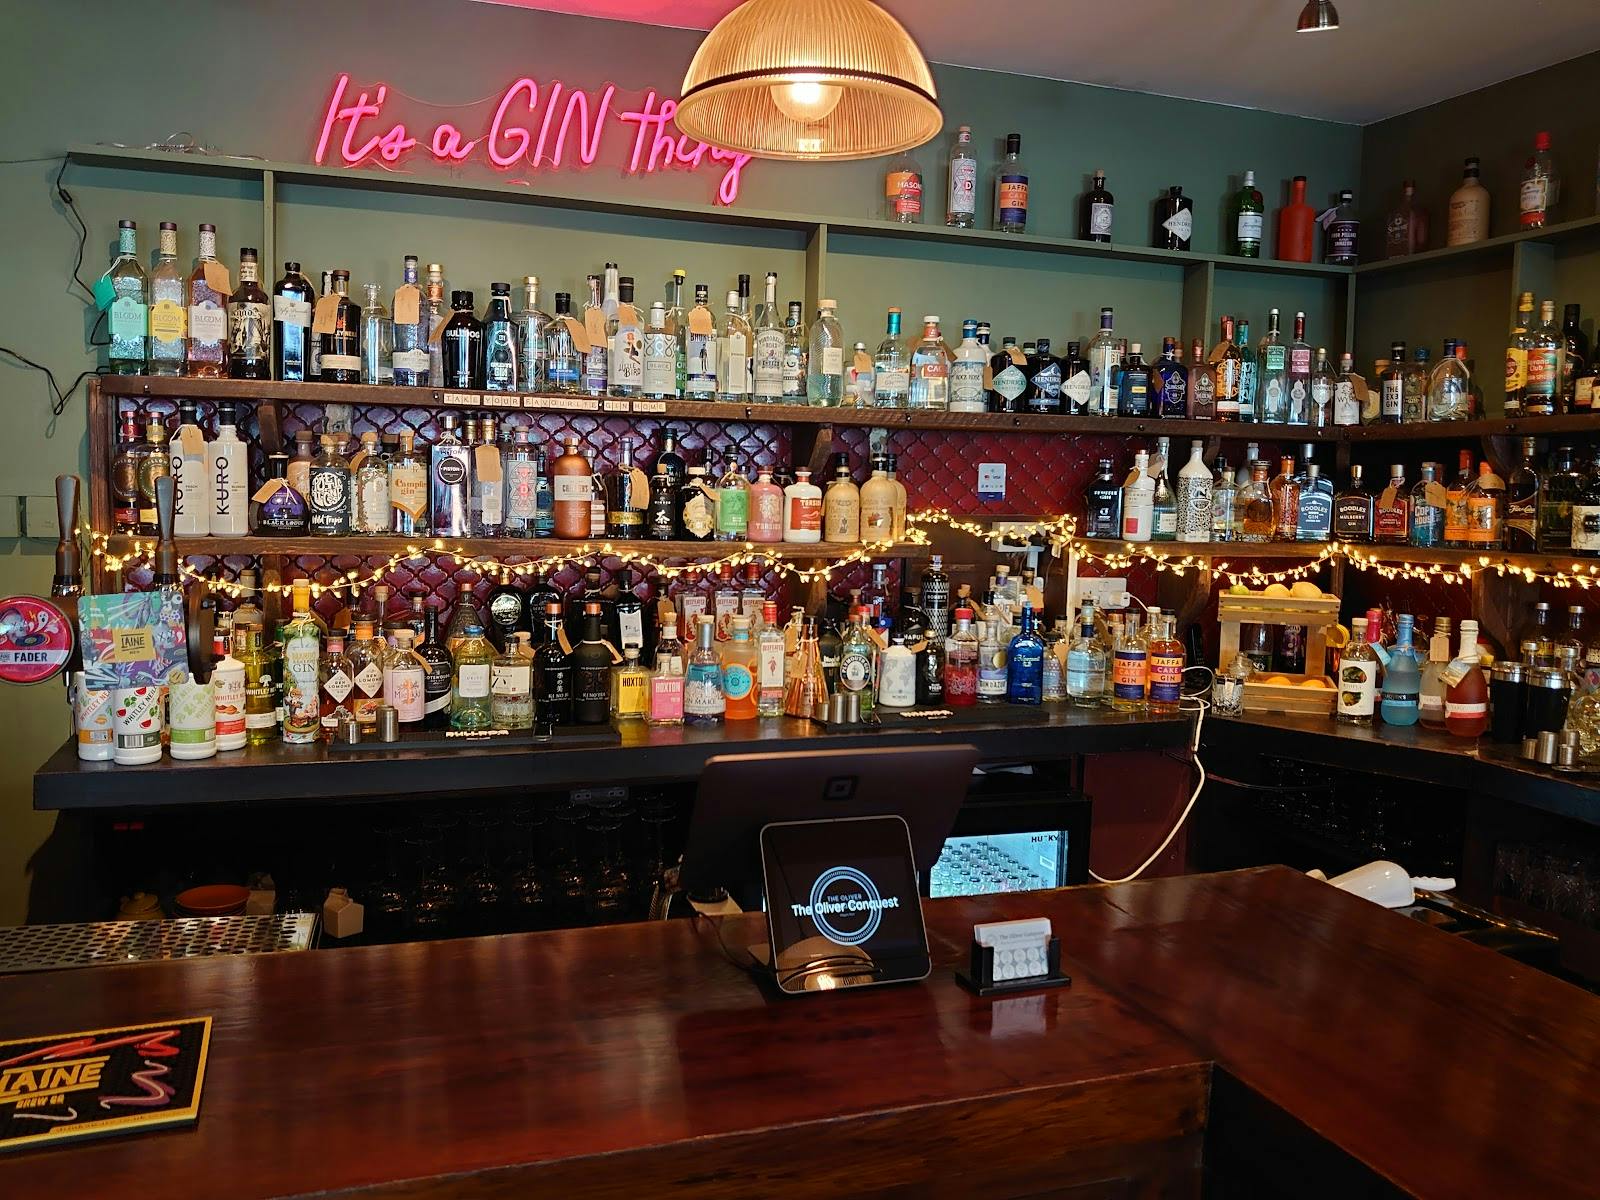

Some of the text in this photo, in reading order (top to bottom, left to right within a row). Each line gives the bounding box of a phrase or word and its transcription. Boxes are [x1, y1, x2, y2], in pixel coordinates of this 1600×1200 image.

[314, 72, 755, 205] It's a GIN thing
[113, 312, 142, 320] BLOOM
[153, 314, 181, 322] BLOOM
[189, 315, 217, 323] BLOOM
[446, 395, 666, 411] TAKE YOUR FAVOURITE GIN HOME
[443, 466, 460, 474] PISTON
[215, 456, 230, 515] KURO
[401, 489, 415, 497] gin
[1301, 505, 1329, 513] BOODLES
[1339, 505, 1367, 513] BOODLES
[121, 636, 146, 649] LAINE
[14, 652, 48, 662] FADER
[292, 662, 316, 673] GIN
[1157, 666, 1181, 674] CAKE
[246, 686, 270, 696] WHITLEY
[216, 692, 240, 702] WHITLEY
[124, 702, 149, 726] WHITLEY
[1031, 834, 1059, 843] HUKY
[791, 896, 900, 917] The Oliver Conquest
[0, 1062, 106, 1095] LAINE
[16, 1094, 65, 1109] BREW CO
